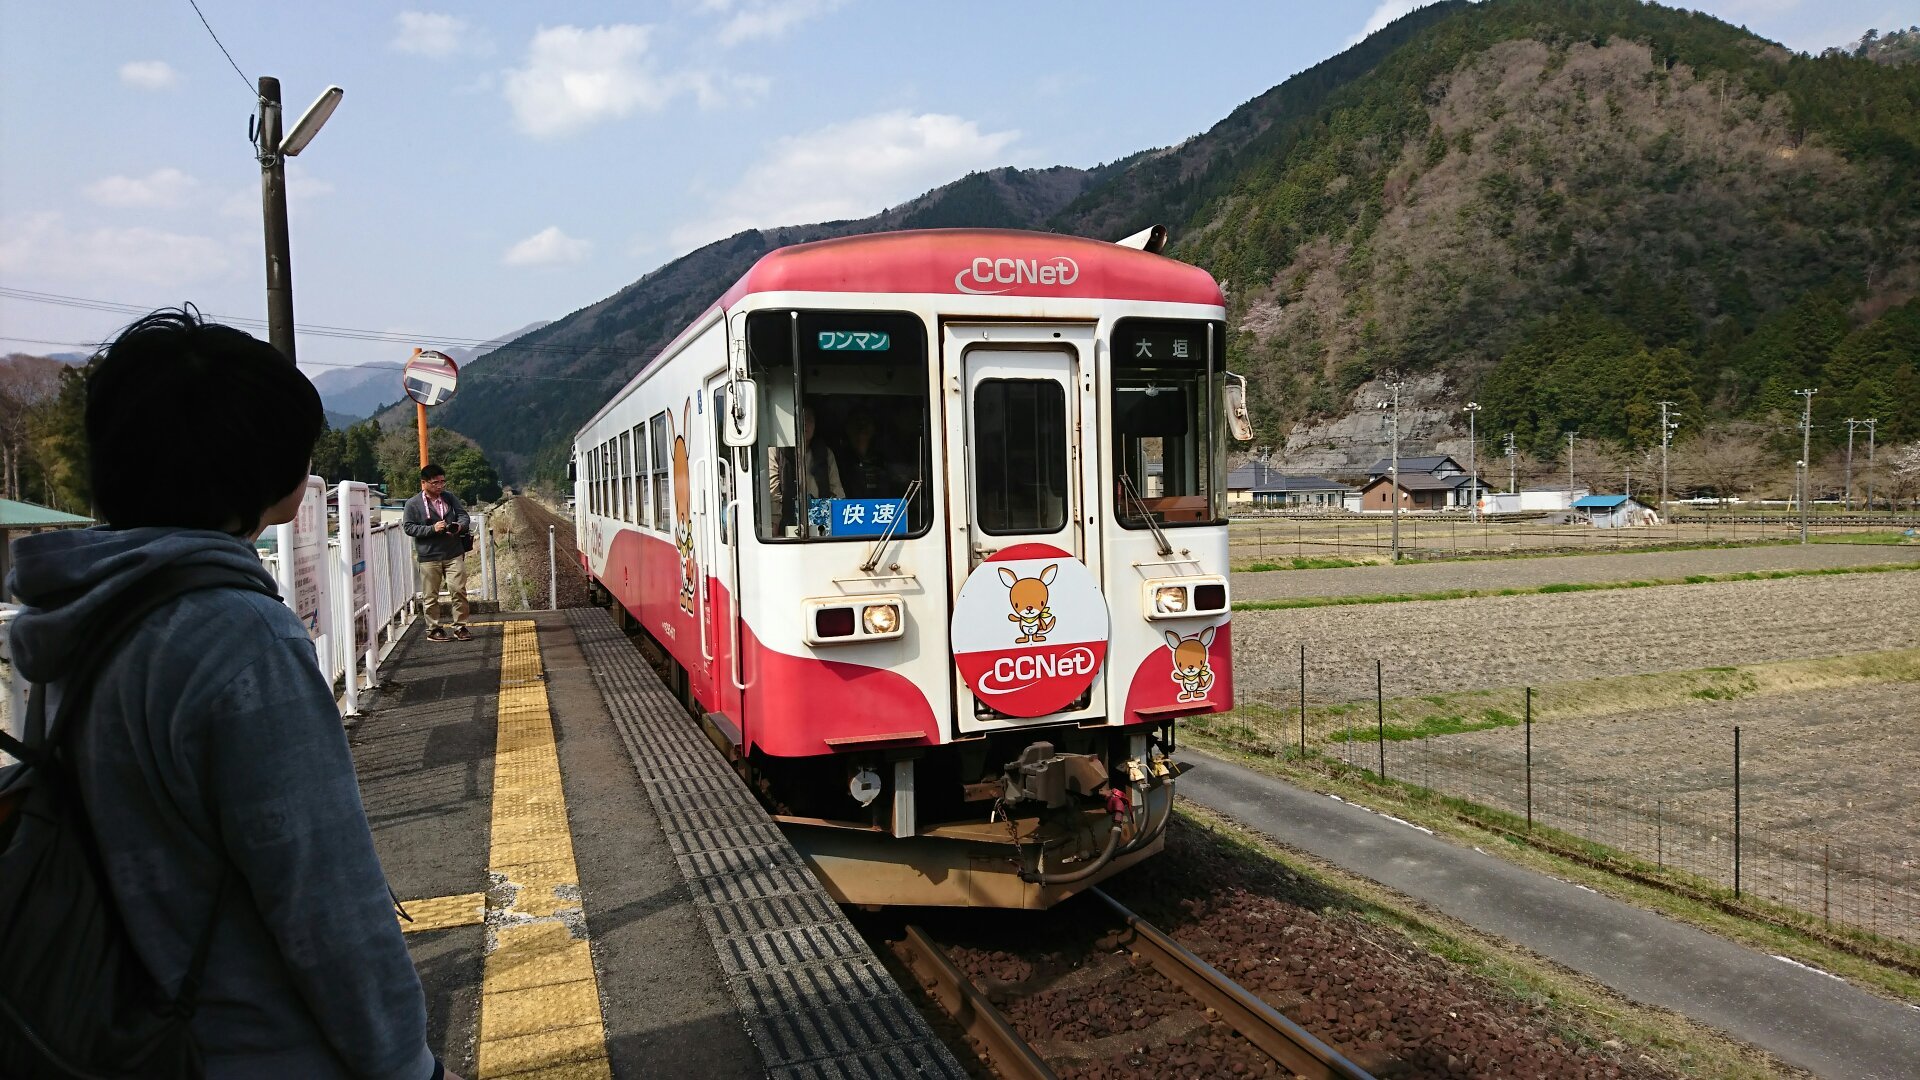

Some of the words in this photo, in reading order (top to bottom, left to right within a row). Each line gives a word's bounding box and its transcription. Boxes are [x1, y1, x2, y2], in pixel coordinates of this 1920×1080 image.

[971, 256, 1079, 286] CCNet
[819, 331, 887, 350] ワンマン
[1136, 338, 1189, 358] 大垣
[842, 503, 896, 525] 快速
[993, 648, 1095, 683] CCNet
